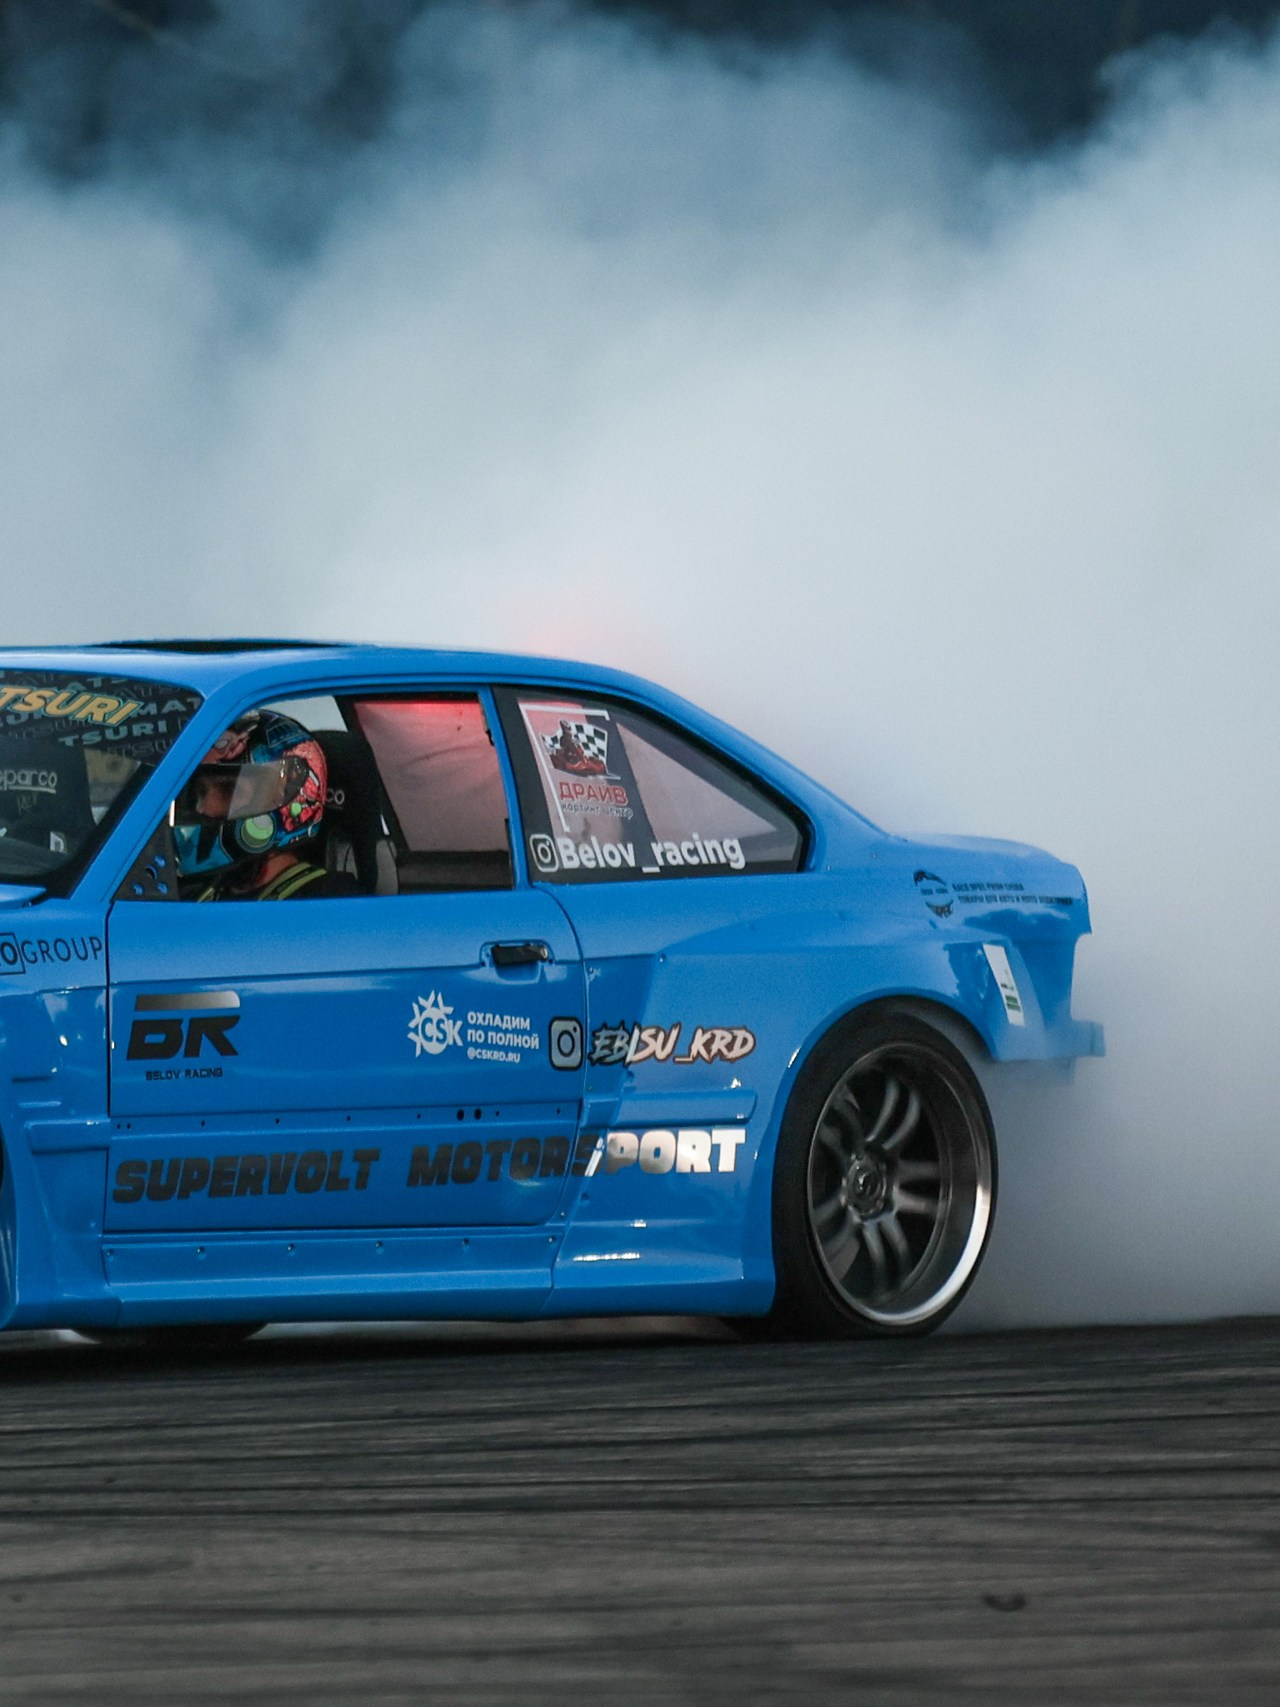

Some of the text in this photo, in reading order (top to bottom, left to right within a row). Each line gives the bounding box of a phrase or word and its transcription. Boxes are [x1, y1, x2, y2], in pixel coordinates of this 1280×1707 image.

[467, 1011, 530, 1030] ОХЛАДИМ
[421, 1017, 463, 1046] CSK
[467, 1029, 539, 1050] ПО ПОЛНОЙ
[467, 1047, 520, 1063] @CSKRD.RU
[146, 1068, 223, 1081] BELOV RACING
[112, 1129, 746, 1203] SUPERVOLT MOTORSPORT
